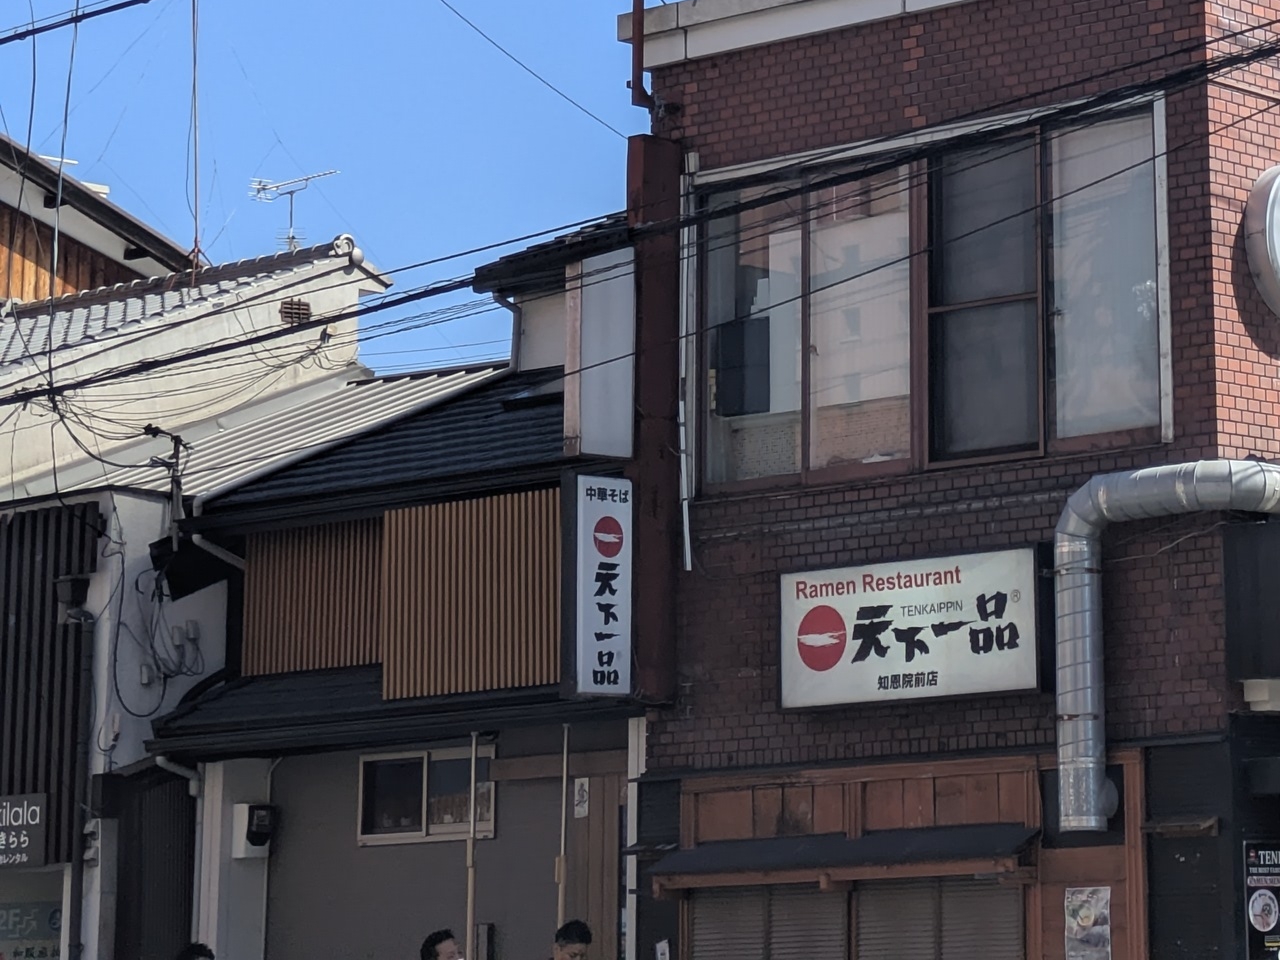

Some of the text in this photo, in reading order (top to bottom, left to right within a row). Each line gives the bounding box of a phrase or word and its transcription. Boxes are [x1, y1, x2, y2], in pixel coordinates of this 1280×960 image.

[585, 486, 629, 504] 中華そば
[795, 565, 961, 600] Ramen Restaurant
[900, 599, 963, 617] TENKAIPPIN
[592, 562, 620, 685] 天下一品
[851, 591, 1020, 664] 天下一品
[877, 671, 939, 691] 知恩院前店
